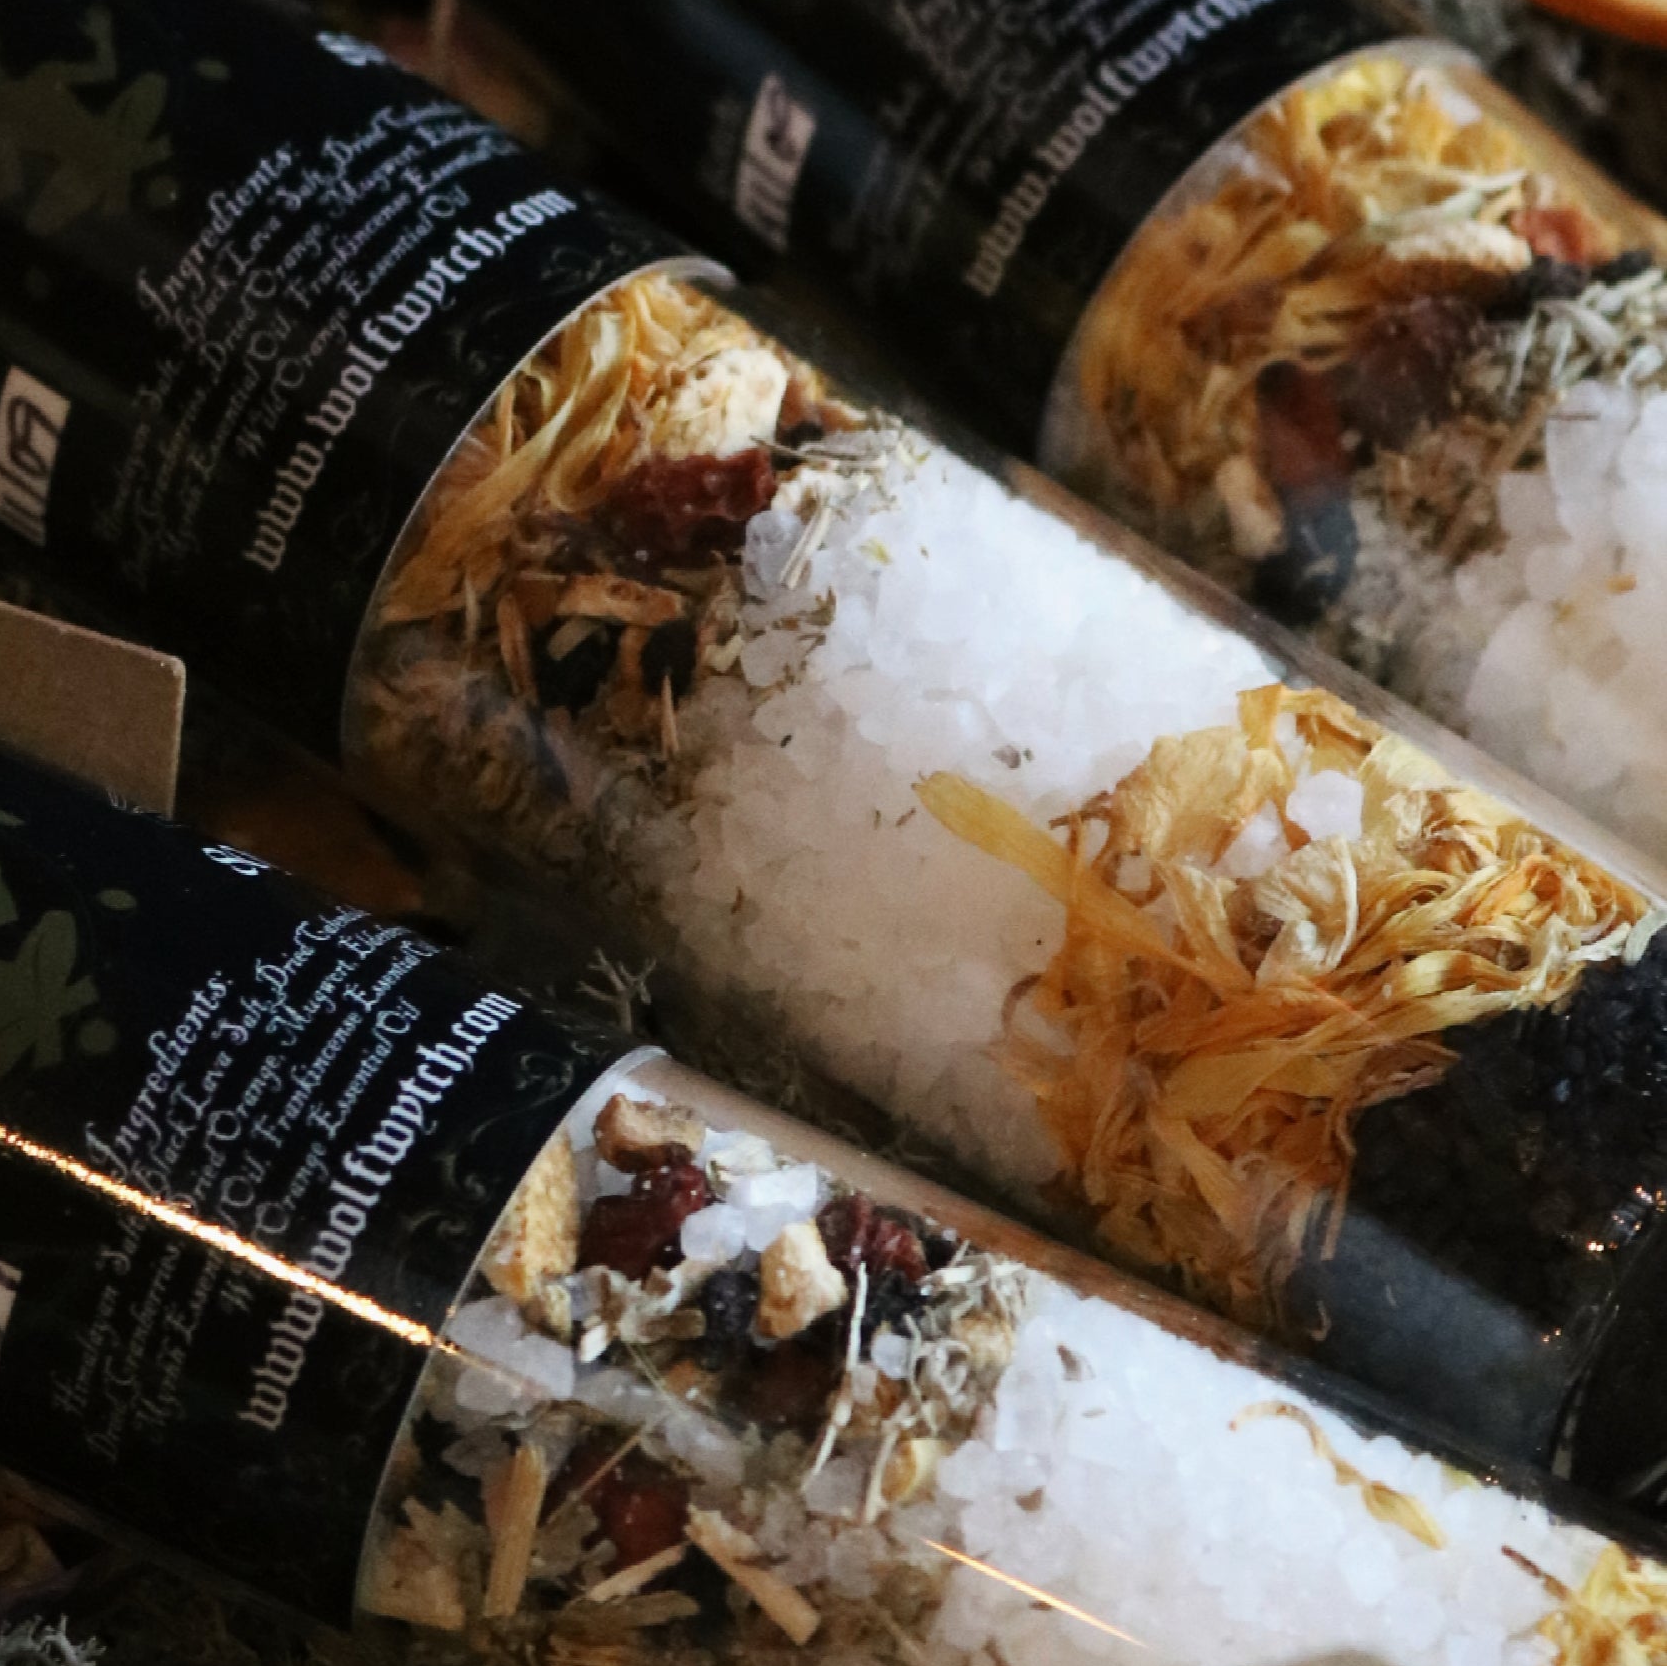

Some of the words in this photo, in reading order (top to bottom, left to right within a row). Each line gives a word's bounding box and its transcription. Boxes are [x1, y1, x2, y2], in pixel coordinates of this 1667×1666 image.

[241, 186, 576, 573] www.wolfwytch.com
[84, 970, 232, 1183] Ingredients:
[239, 991, 523, 1432] wwwwolfwytch.com
[255, 1141, 327, 1234] Orange
[306, 1029, 393, 1141] Essential
[374, 996, 421, 1035] Oil
